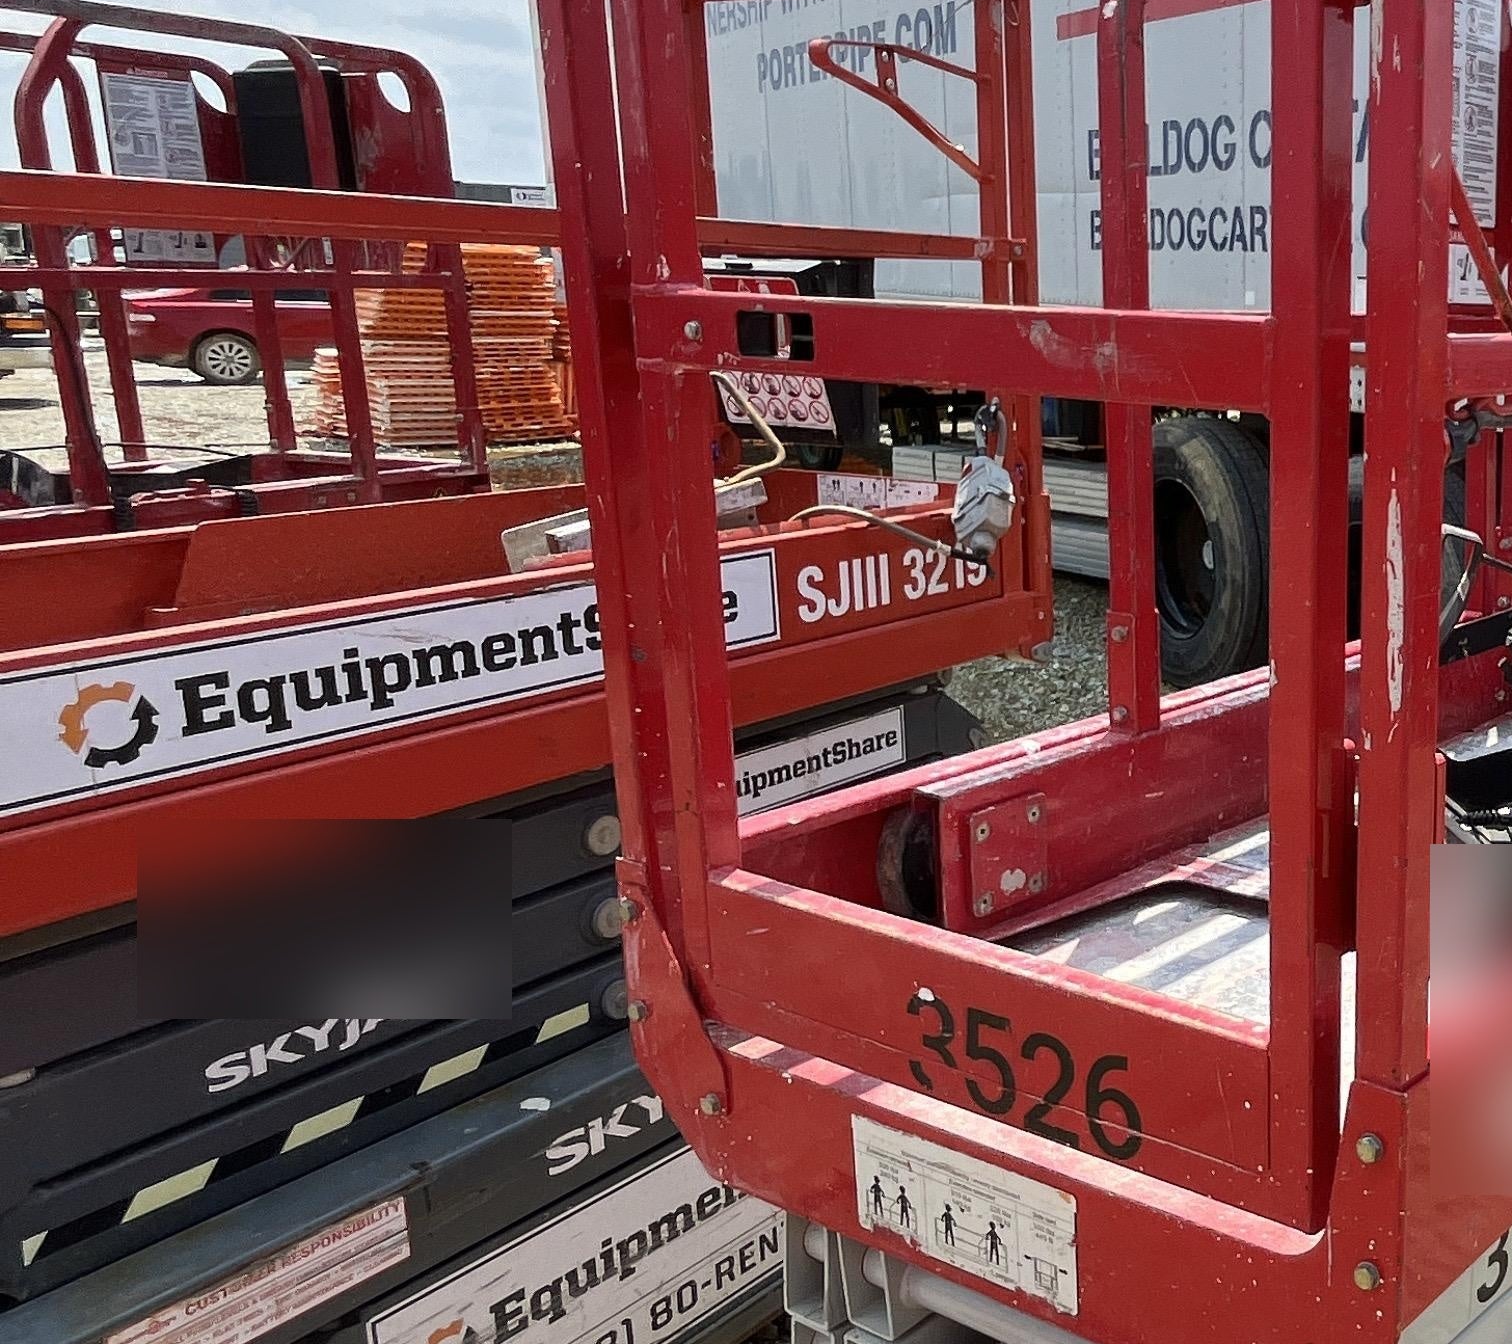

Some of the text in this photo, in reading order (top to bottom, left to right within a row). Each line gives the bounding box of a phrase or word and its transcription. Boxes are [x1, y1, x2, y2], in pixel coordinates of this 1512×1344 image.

[797, 548, 987, 624] SJIII 3219
[205, 1018, 384, 1093] SKYJ
[906, 991, 1142, 1161] 3526
[650, 1220, 784, 1332] 80-REN
